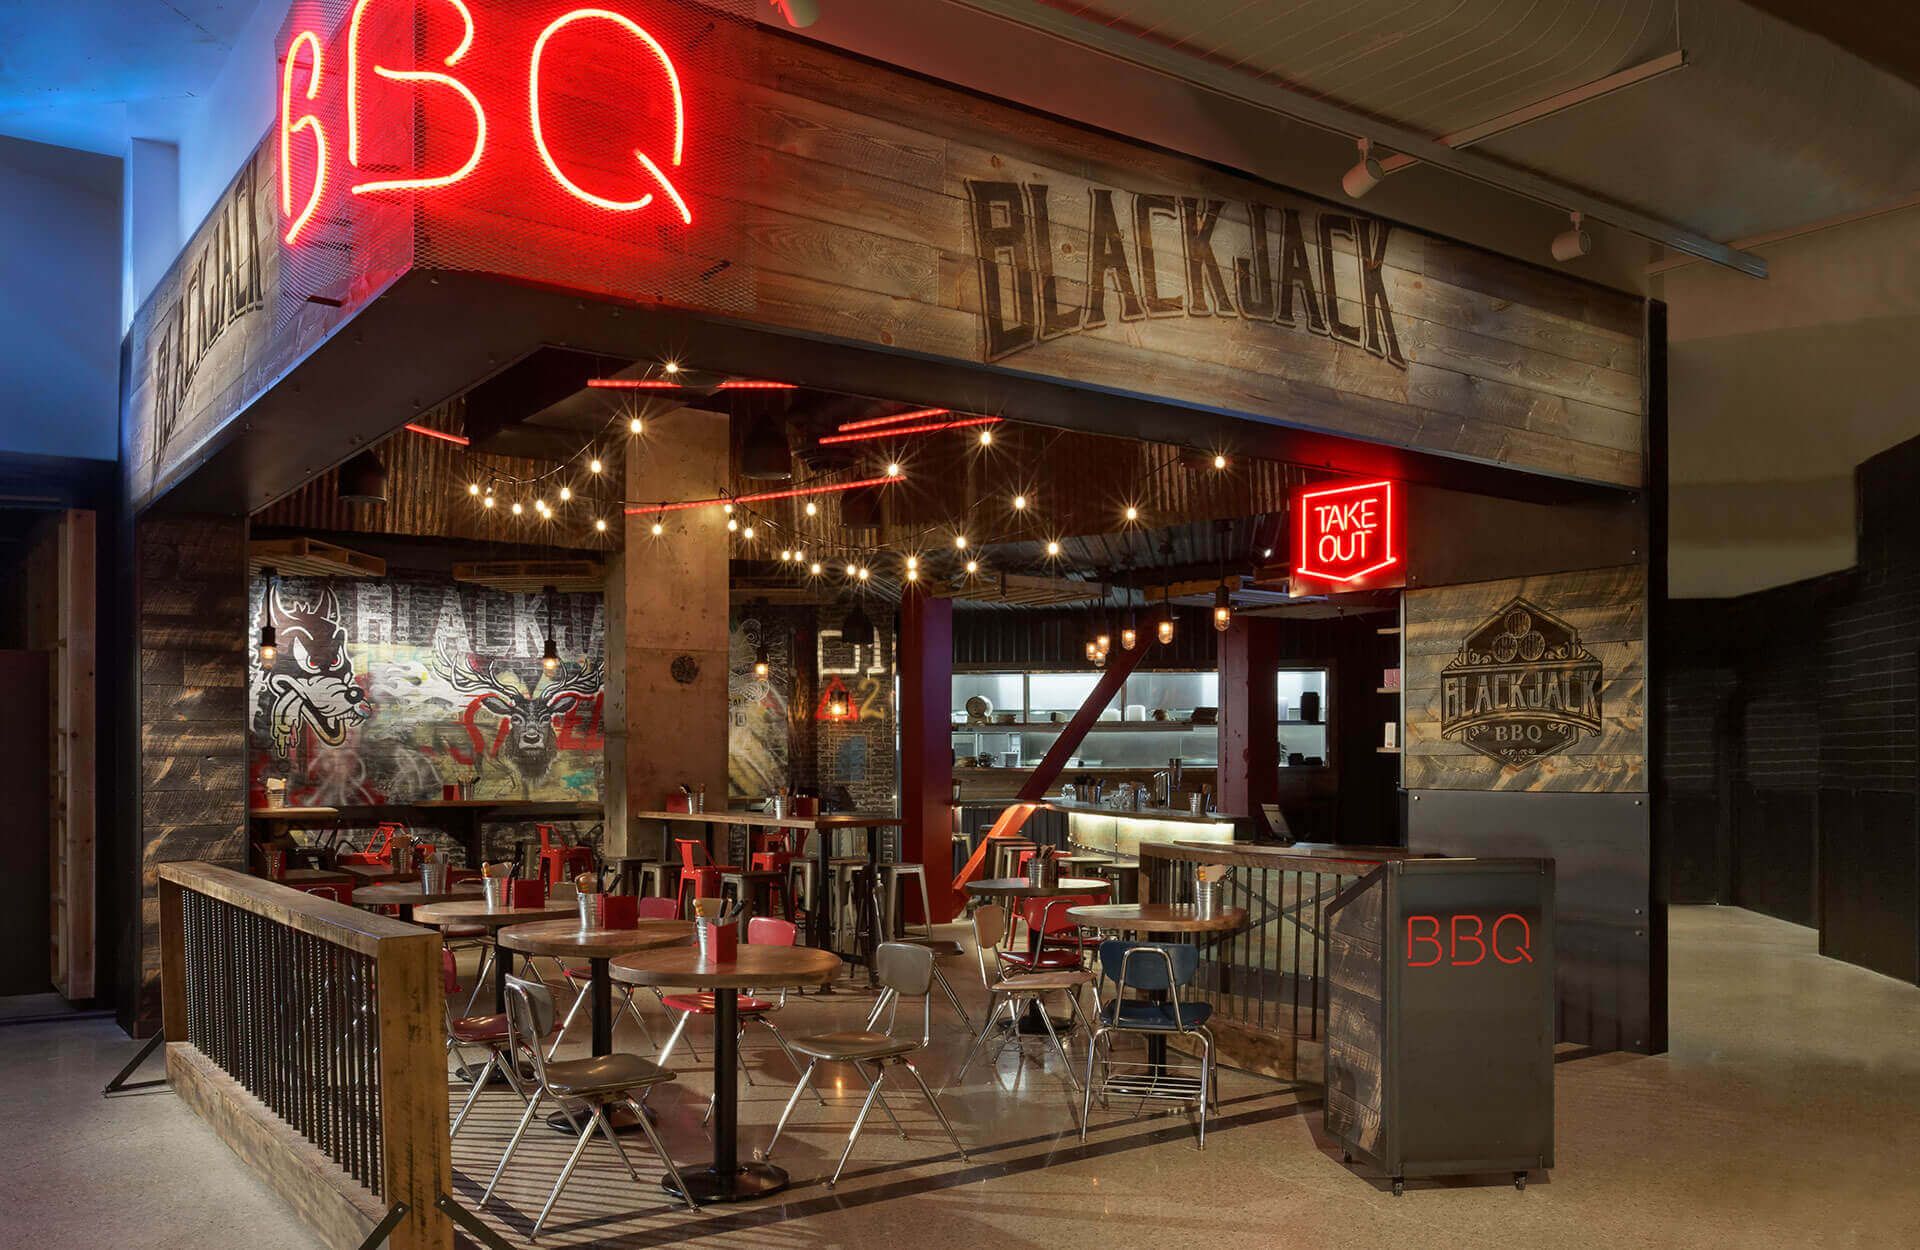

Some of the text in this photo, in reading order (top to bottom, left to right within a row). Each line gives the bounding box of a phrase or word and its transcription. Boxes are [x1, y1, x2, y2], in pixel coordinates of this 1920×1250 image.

[279, 0, 692, 246] BBQ
[965, 177, 1407, 371] BLACKJACK
[1314, 498, 1378, 533] TAKE
[1318, 529, 1374, 563] OUT
[1442, 670, 1602, 725] BLACKJACK
[1495, 724, 1543, 743] BBQ
[1408, 913, 1534, 967] BBQ
